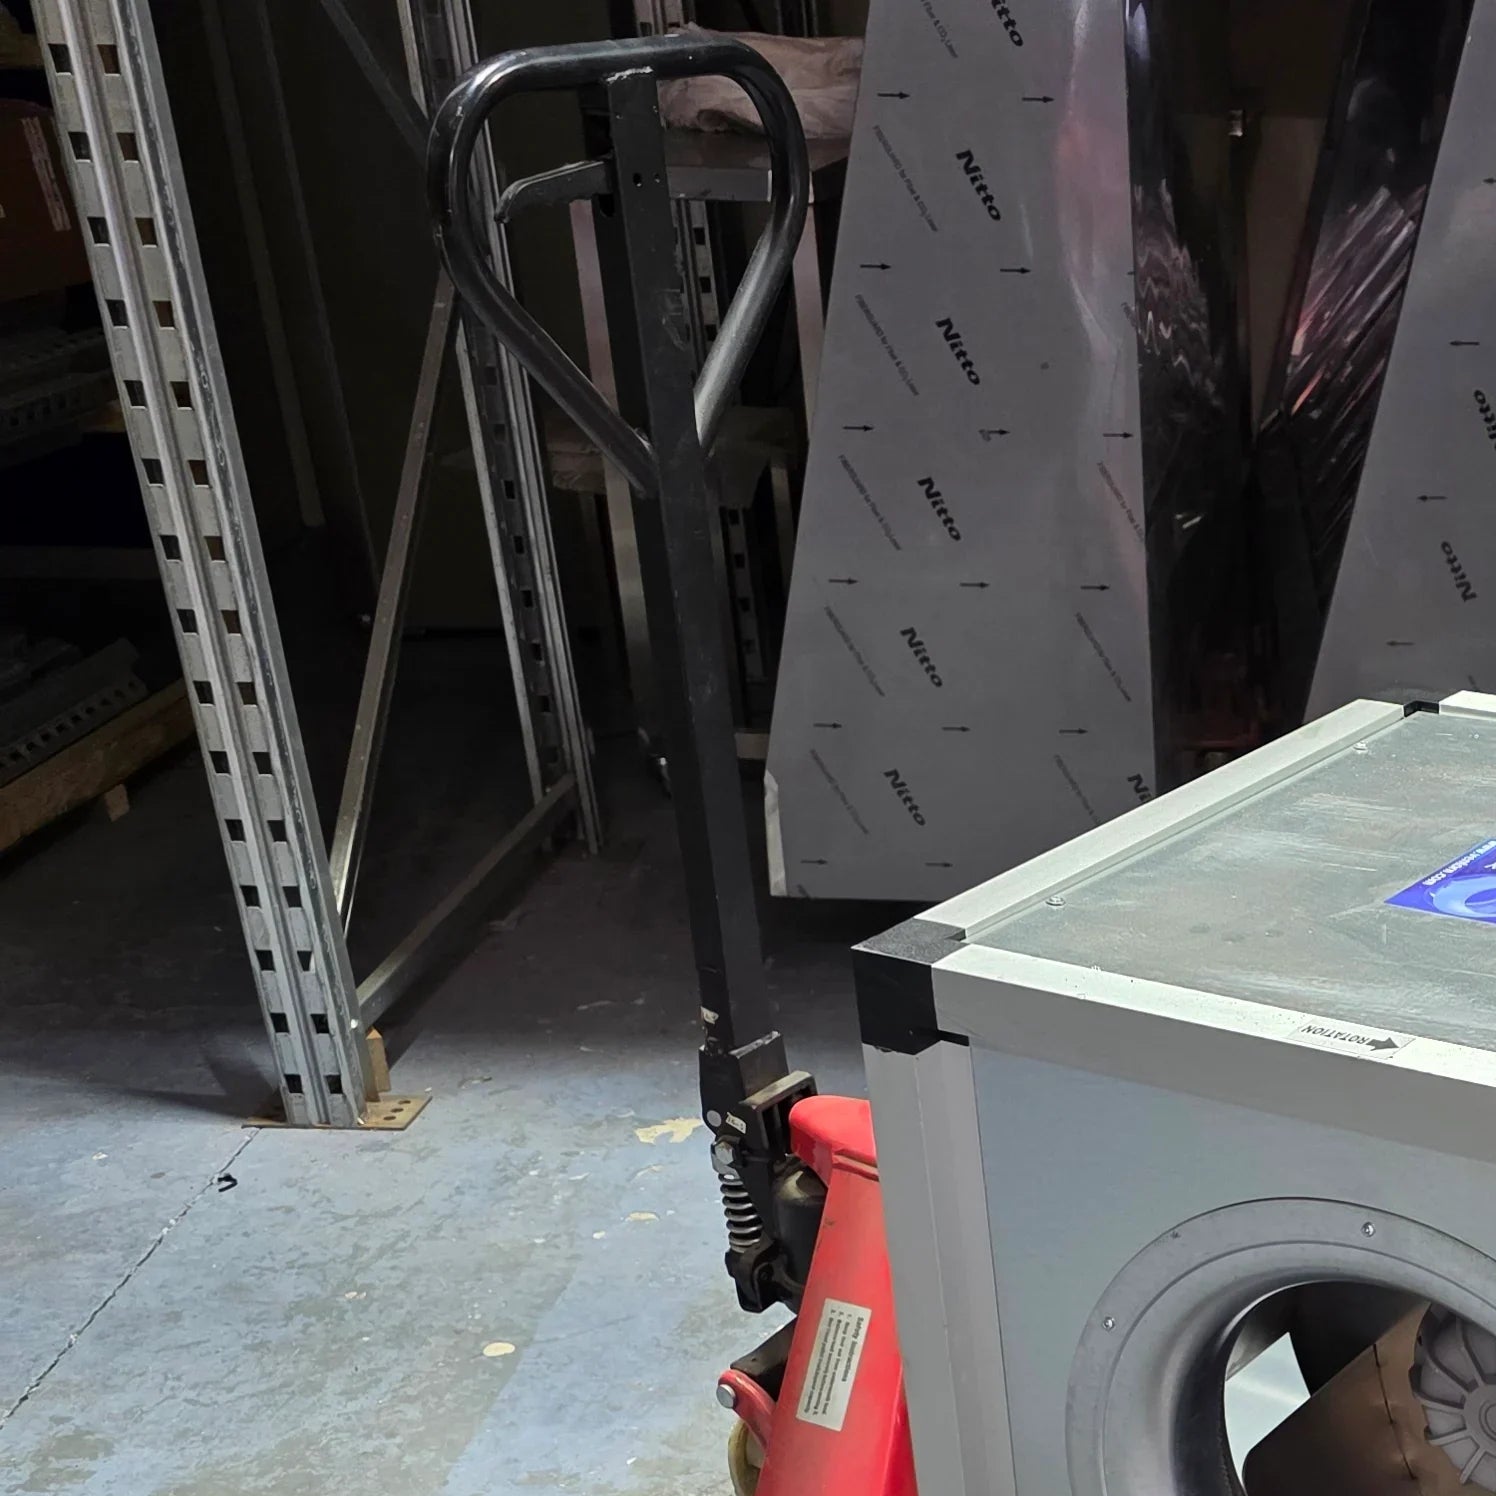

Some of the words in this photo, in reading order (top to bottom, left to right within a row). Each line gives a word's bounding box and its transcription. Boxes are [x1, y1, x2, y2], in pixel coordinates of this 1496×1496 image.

[992, 0, 1023, 46] itto
[957, 150, 1000, 220] Nitto
[936, 318, 979, 384] Nitto
[918, 478, 960, 540] Nitto
[1442, 542, 1476, 601] Nitto
[901, 628, 942, 687] Nitto
[884, 770, 924, 825] Nitto
[1301, 1025, 1370, 1045] ROTATION
